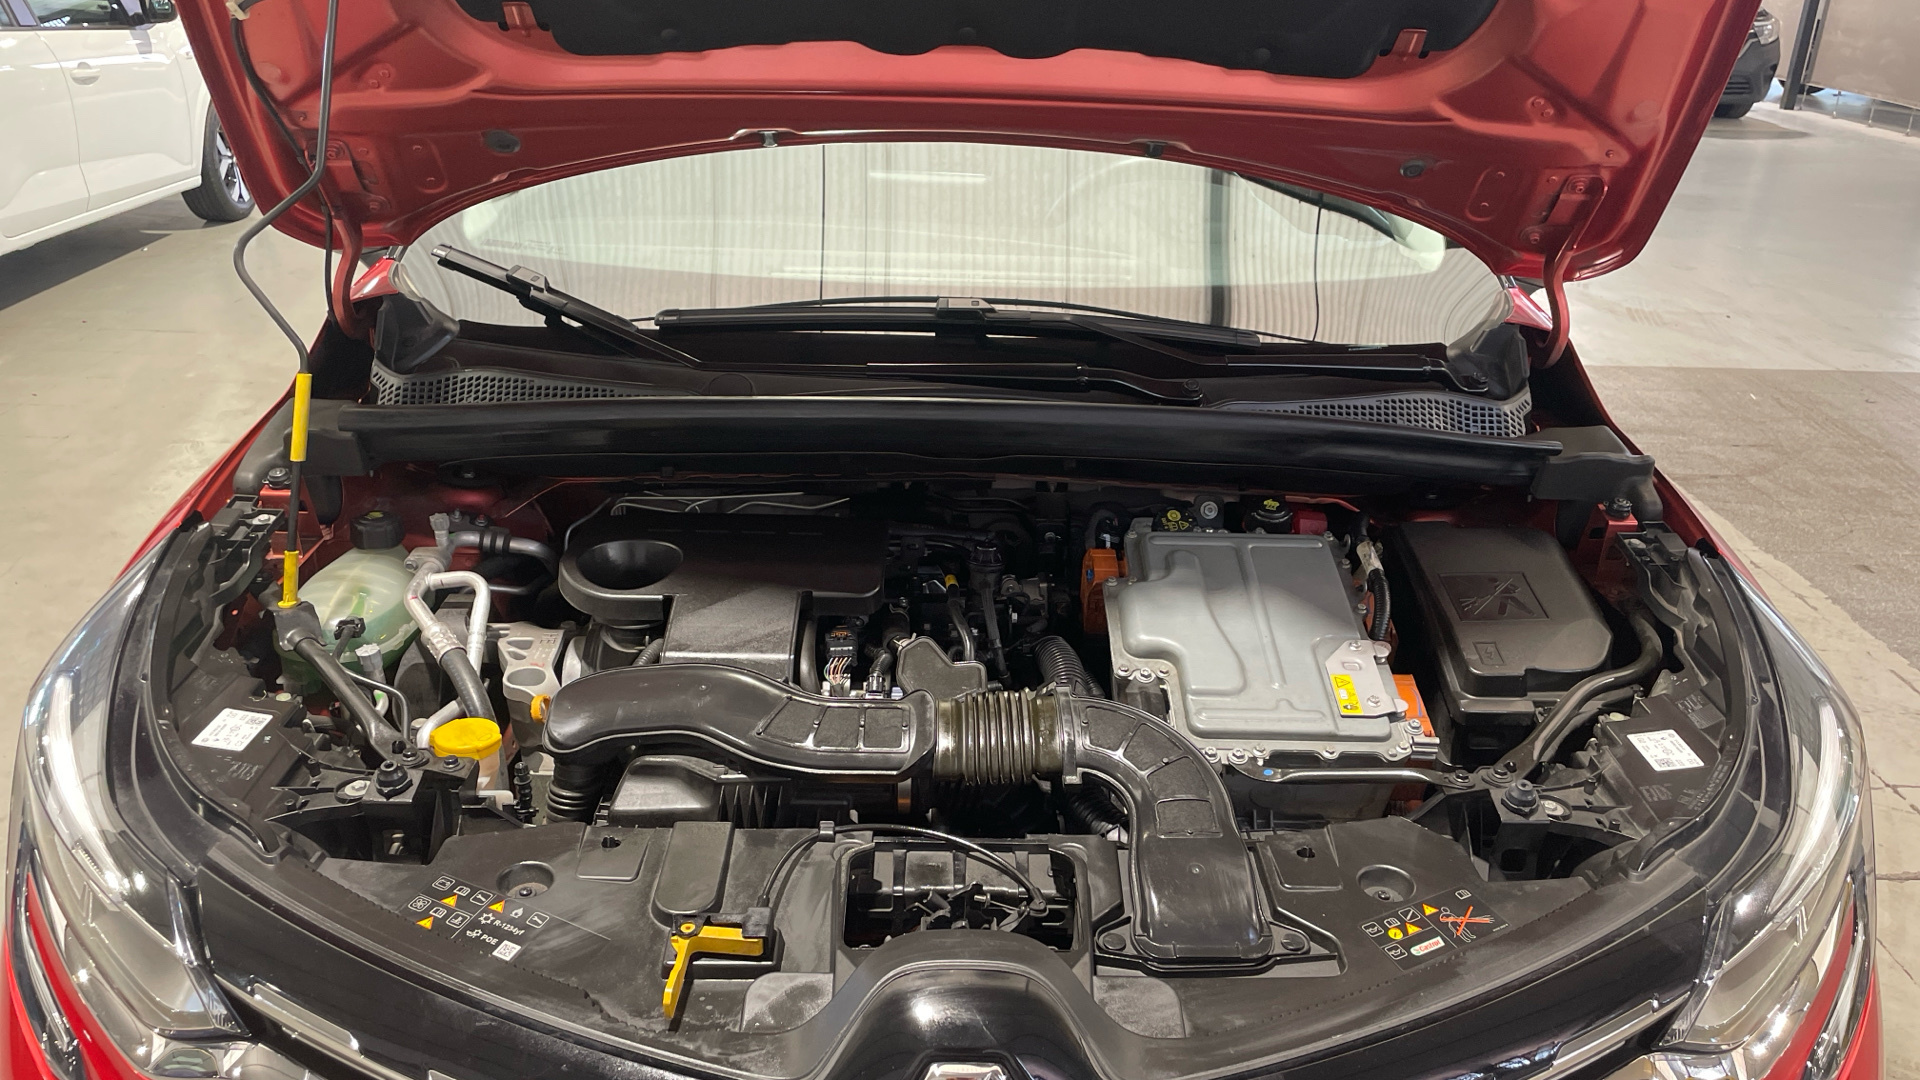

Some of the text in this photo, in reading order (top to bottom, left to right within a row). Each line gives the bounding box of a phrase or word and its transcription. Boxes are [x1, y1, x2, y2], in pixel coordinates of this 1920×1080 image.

[493, 920, 525, 935] R-1234yf
[480, 934, 498, 945] POE
[1419, 939, 1440, 952] Castrol
